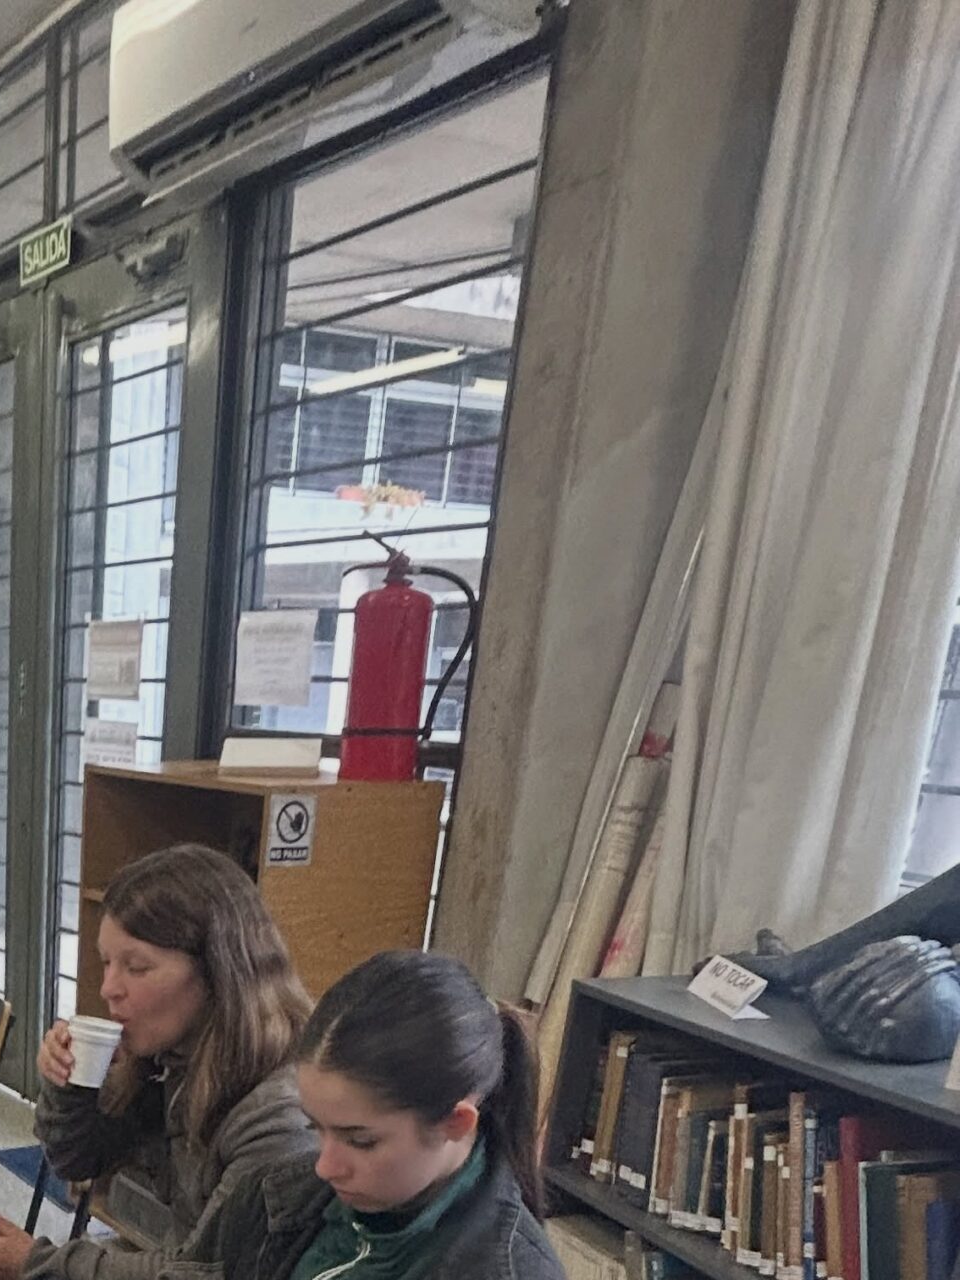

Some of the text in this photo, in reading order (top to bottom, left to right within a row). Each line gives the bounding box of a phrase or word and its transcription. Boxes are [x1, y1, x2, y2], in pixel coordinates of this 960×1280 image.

[24, 230, 66, 274] SALIDA
[710, 961, 756, 991] NO TOCAR
